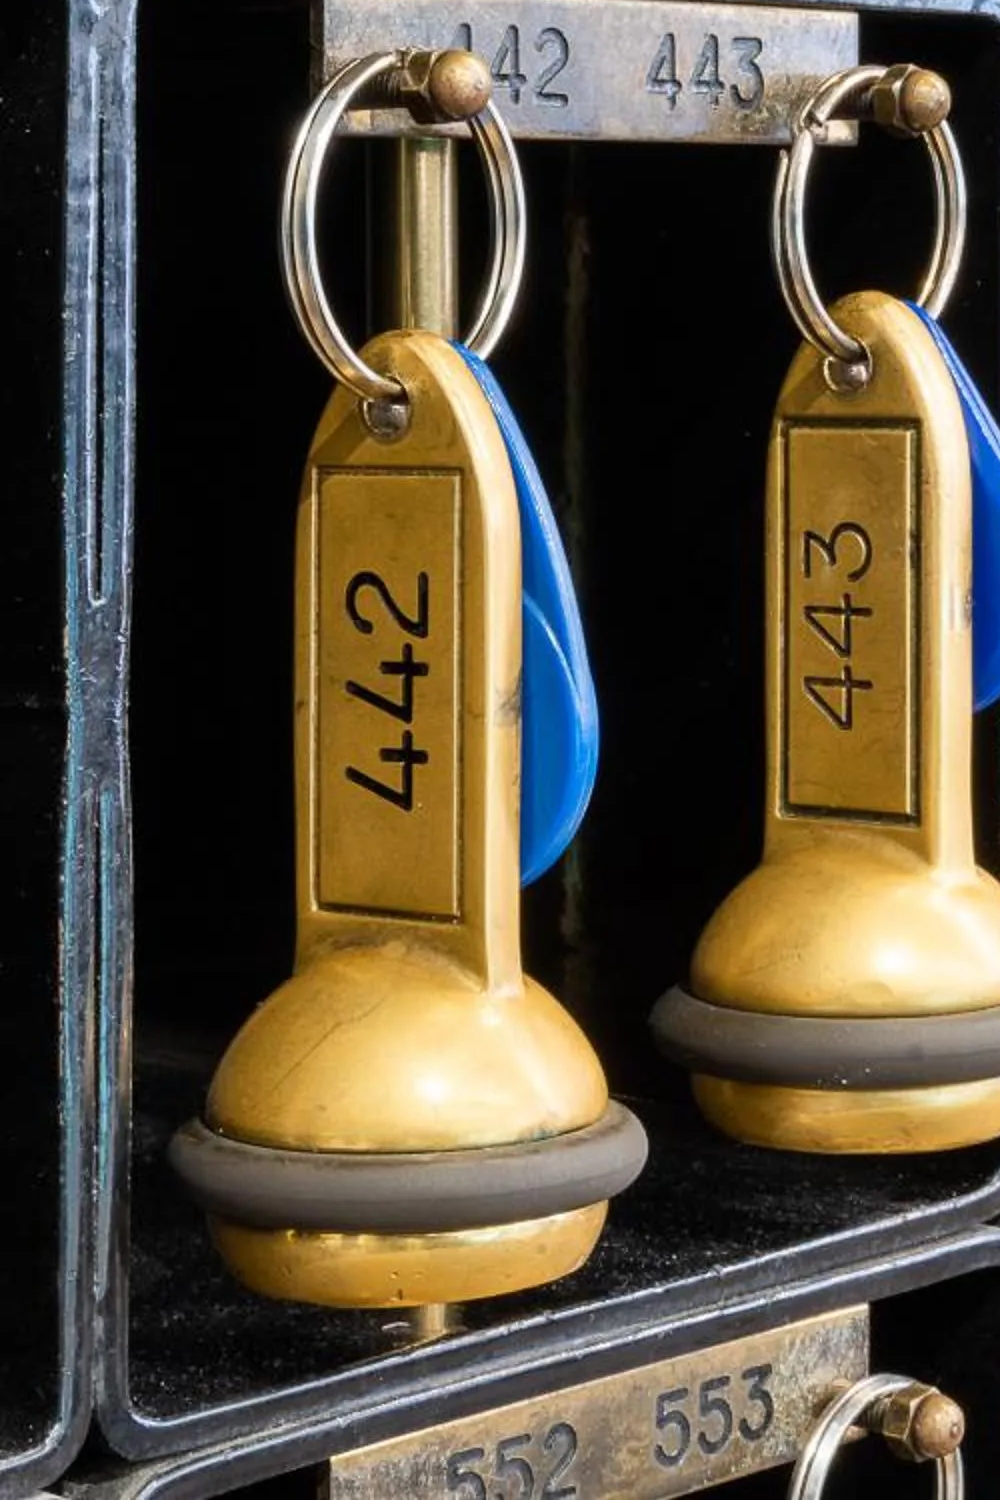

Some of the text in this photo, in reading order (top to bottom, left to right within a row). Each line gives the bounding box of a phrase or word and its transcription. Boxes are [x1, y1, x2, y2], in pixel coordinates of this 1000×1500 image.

[645, 32, 765, 111] 443
[345, 571, 430, 812] 442
[802, 521, 873, 730] 443
[446, 1362, 773, 1500] 552 553
